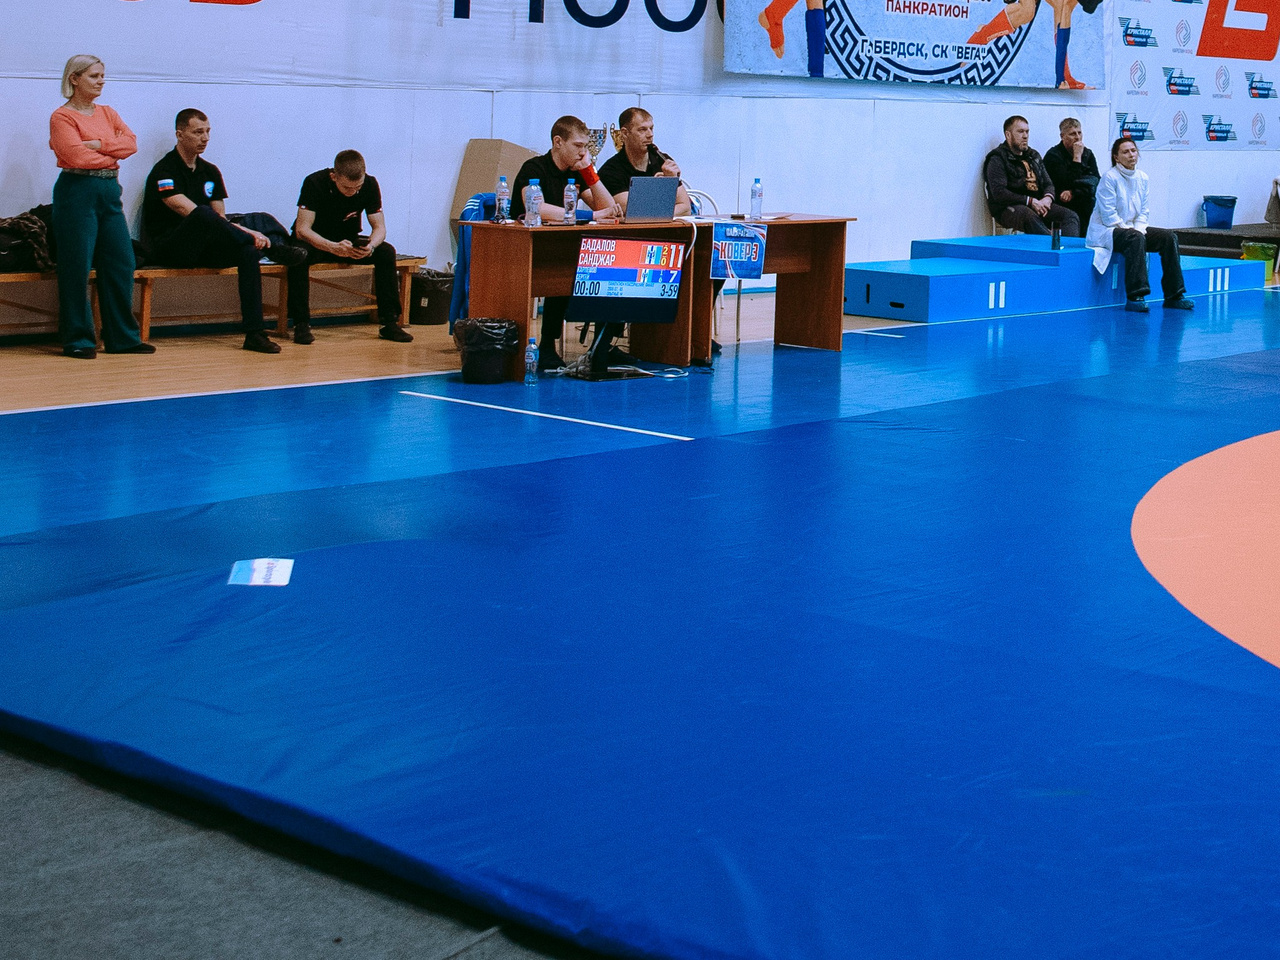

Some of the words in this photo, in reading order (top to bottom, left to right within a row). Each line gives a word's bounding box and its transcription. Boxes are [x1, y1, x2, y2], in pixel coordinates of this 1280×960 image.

[886, 0, 969, 19] ПАНКРАТИОН
[873, 40, 928, 60] БЕРДСК,
[932, 44, 948, 58] СК
[952, 46, 986, 61] "ВЕГА"
[581, 238, 616, 253] БАДАЛОВ
[720, 241, 752, 260] КОВЕР
[752, 243, 759, 261] 3
[578, 253, 616, 267] САНДЖАР
[669, 244, 684, 268] 11
[669, 270, 677, 283] 7
[574, 280, 600, 295] 00:00
[660, 284, 678, 297] 3-59
